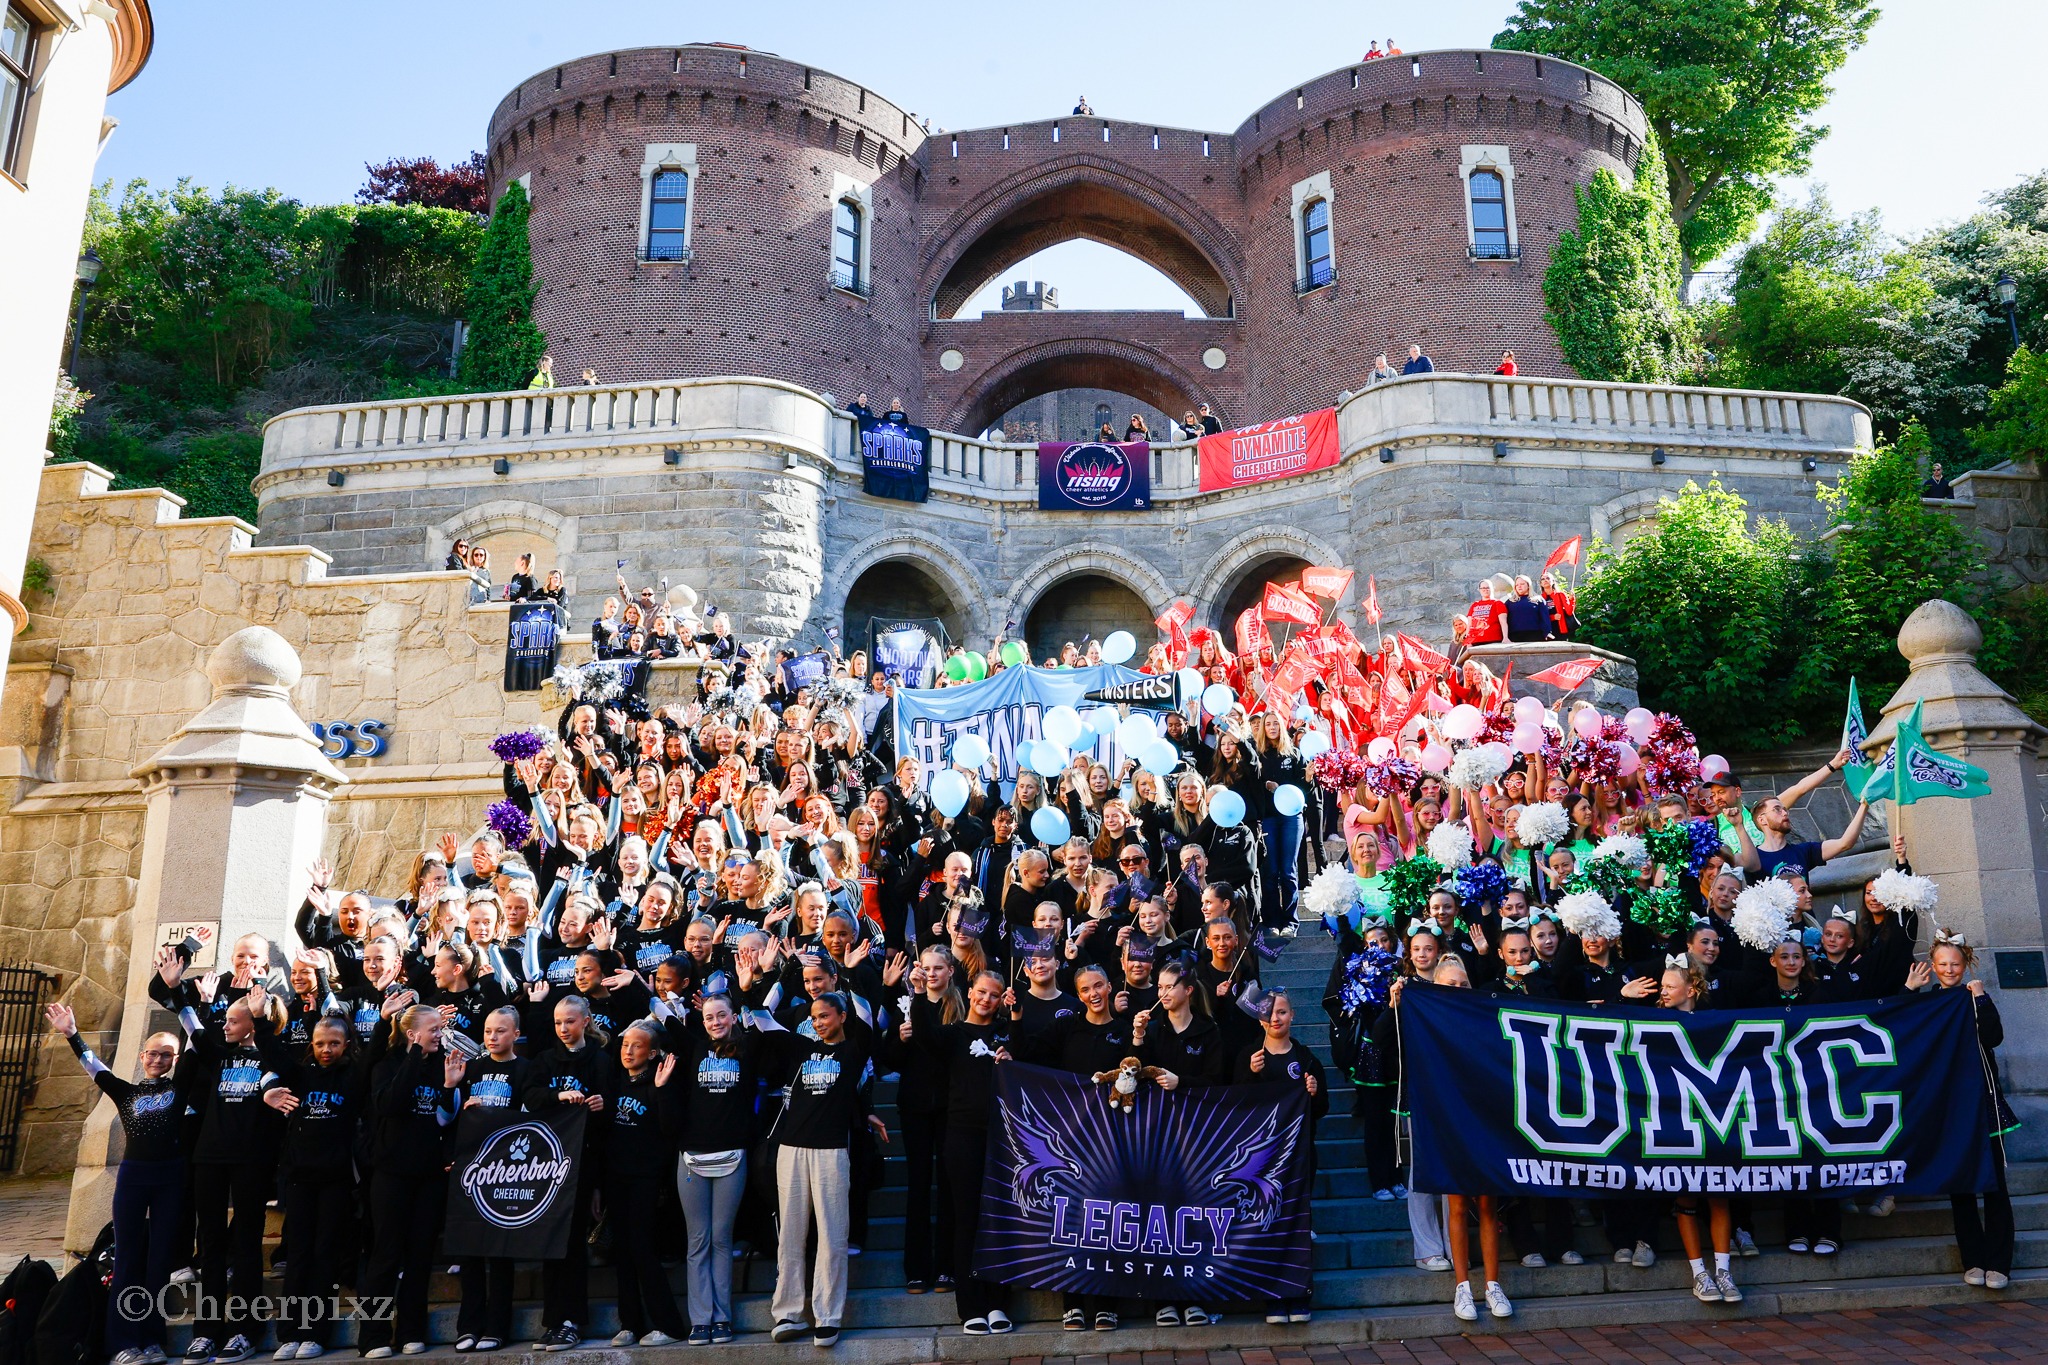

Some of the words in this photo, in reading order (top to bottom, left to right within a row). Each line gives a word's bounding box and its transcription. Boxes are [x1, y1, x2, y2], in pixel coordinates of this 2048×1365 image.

[863, 431, 922, 465] SPARKS
[1232, 426, 1306, 462] DYNAMITE
[872, 460, 914, 471] CHEERLEADING
[1233, 453, 1306, 479] CHEERLEADING
[1067, 474, 1121, 491] rising
[1268, 594, 1316, 623] DYNAMITE
[876, 646, 935, 668] SHOOTING
[1100, 674, 1172, 700] TWISTERS
[233, 1059, 244, 1068] WE
[245, 1058, 260, 1068] ARE
[244, 1081, 260, 1092] ONE
[482, 1074, 494, 1082] WE
[494, 1073, 510, 1082] ARE
[725, 1072, 740, 1082] ONE
[1498, 1007, 1903, 1158] UMC
[463, 1156, 570, 1194] Gothenburg
[1507, 1158, 1626, 1190] UNITED
[1634, 1165, 1812, 1192] MOVEMENT
[1819, 1160, 1907, 1188] CHEER
[493, 1188, 520, 1200] CHEER
[520, 1188, 535, 1200] ONE
[1050, 1196, 1235, 1257] LEGACY
[1065, 1257, 1215, 1278] ALLSTARS
